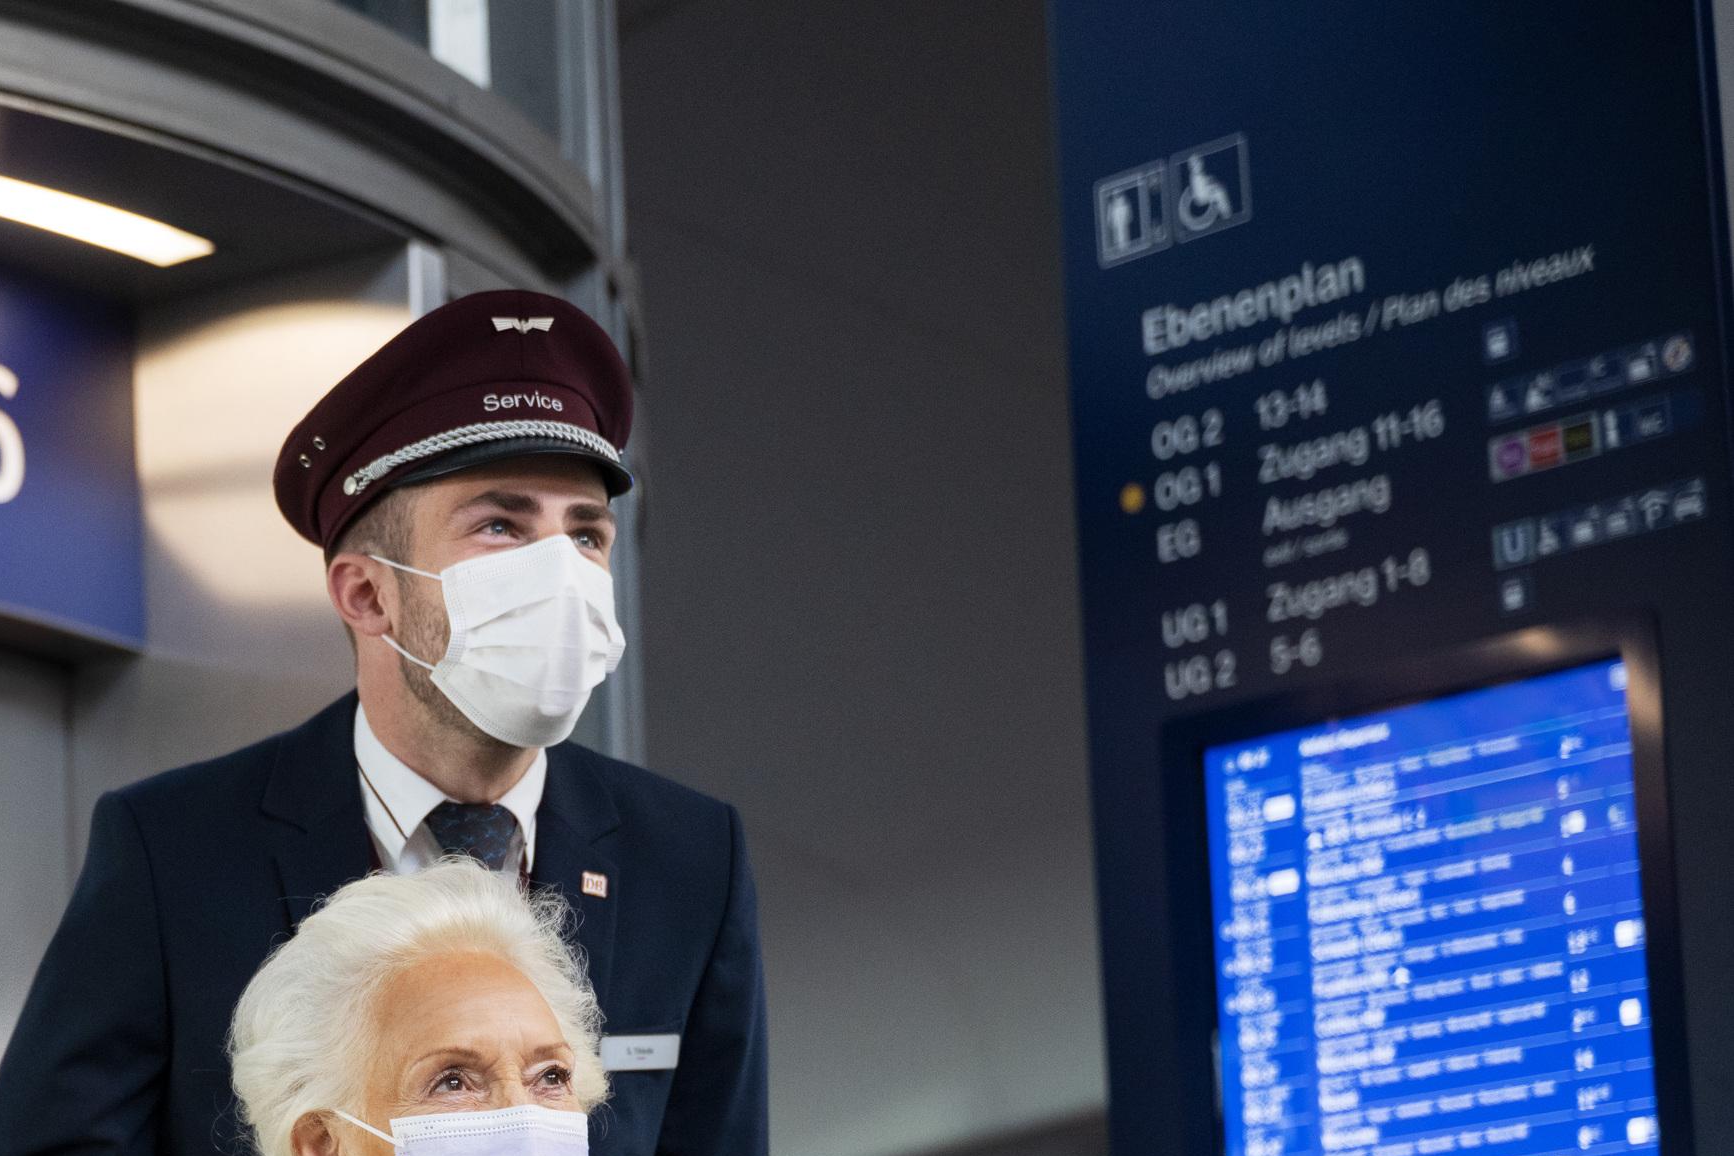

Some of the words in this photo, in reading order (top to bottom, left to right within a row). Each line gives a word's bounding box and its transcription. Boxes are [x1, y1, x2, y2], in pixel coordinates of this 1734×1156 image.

[1141, 255, 1366, 355] Ebenenplan
[1146, 344, 1256, 400] Overview
[1257, 326, 1288, 368] of
[1288, 309, 1362, 361] levels
[1380, 287, 1441, 332] Plan
[1442, 272, 1493, 314] des
[1494, 244, 1597, 299] niveaux
[483, 390, 563, 413] Service
[1201, 407, 1225, 448] 2
[1204, 460, 1223, 498] 1
[1257, 426, 1371, 485] Zugang
[1372, 398, 1446, 451] 11-16
[1161, 603, 1210, 649] UG
[1210, 598, 1229, 636] 1
[1266, 566, 1379, 623] Zugang
[1164, 655, 1212, 699] UG
[1214, 648, 1238, 689] 2
[585, 877, 604, 893] DB
